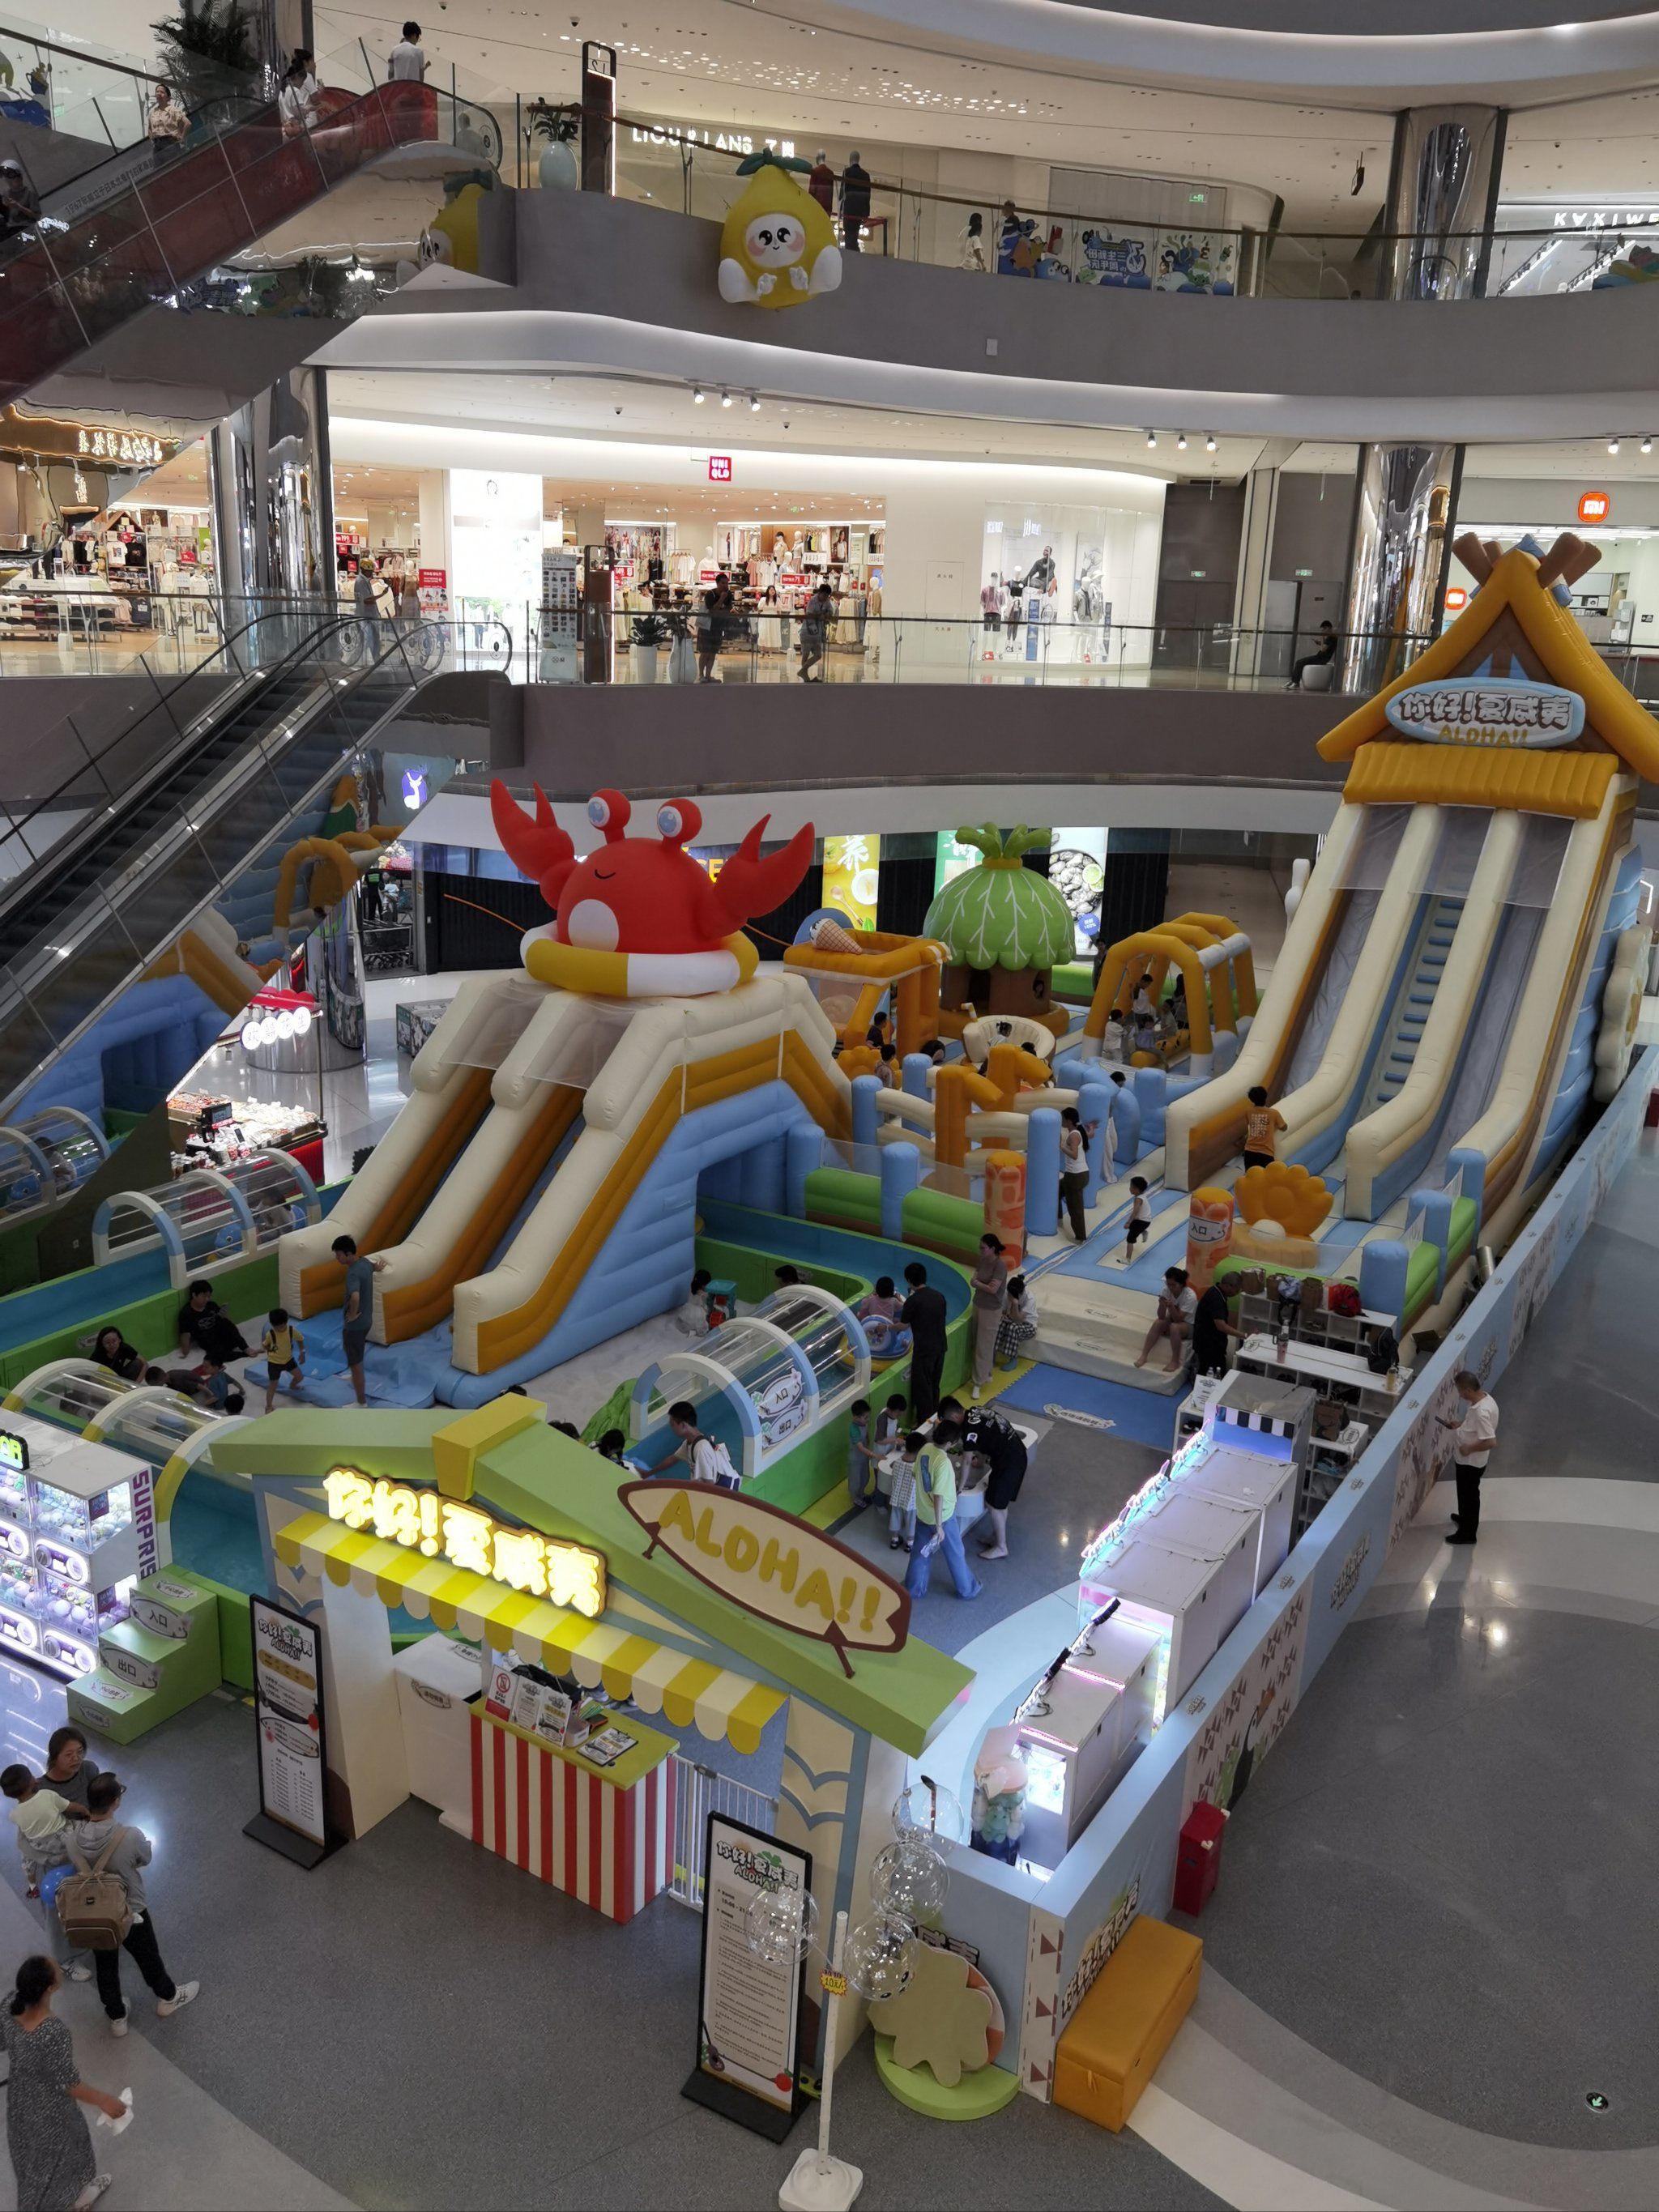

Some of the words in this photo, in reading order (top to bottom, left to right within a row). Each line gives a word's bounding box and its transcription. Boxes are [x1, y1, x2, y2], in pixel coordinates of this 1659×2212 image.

[711, 458, 728, 469] UNI
[711, 468, 730, 479] QLO
[1192, 1222, 1207, 1235] 入口
[775, 1387, 789, 1404] 入口
[778, 1419, 791, 1434] 出口
[659, 1490, 881, 1633] ALOHA!!
[149, 1609, 168, 1629] 入口
[117, 1658, 137, 1677] 出口
